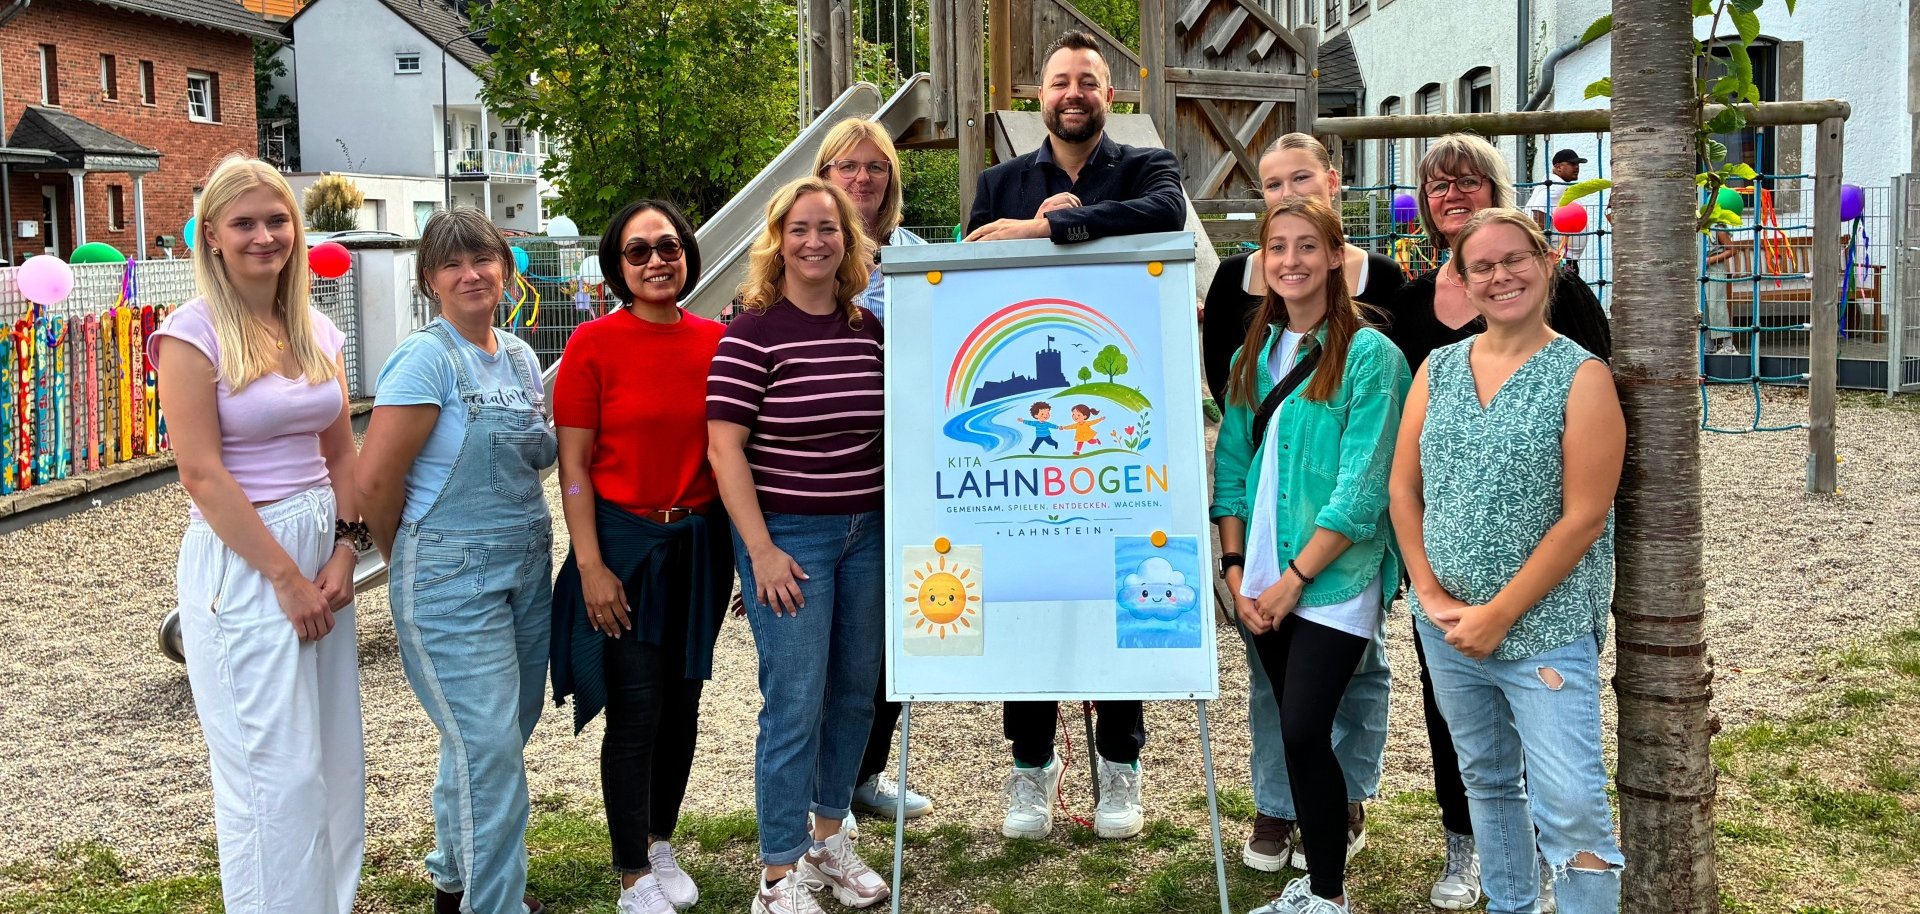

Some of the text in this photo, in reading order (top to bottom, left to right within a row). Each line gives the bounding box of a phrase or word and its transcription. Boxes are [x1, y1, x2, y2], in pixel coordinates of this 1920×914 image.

[948, 456, 982, 468] KITA
[936, 464, 1168, 499] LAHNBOGEN
[946, 505, 1004, 513] GEMEINSAM.
[1052, 502, 1110, 510] ENTDECKEN.
[1114, 500, 1162, 508] WACHSEN.
[1008, 526, 1102, 537] LAHNSTEIN
